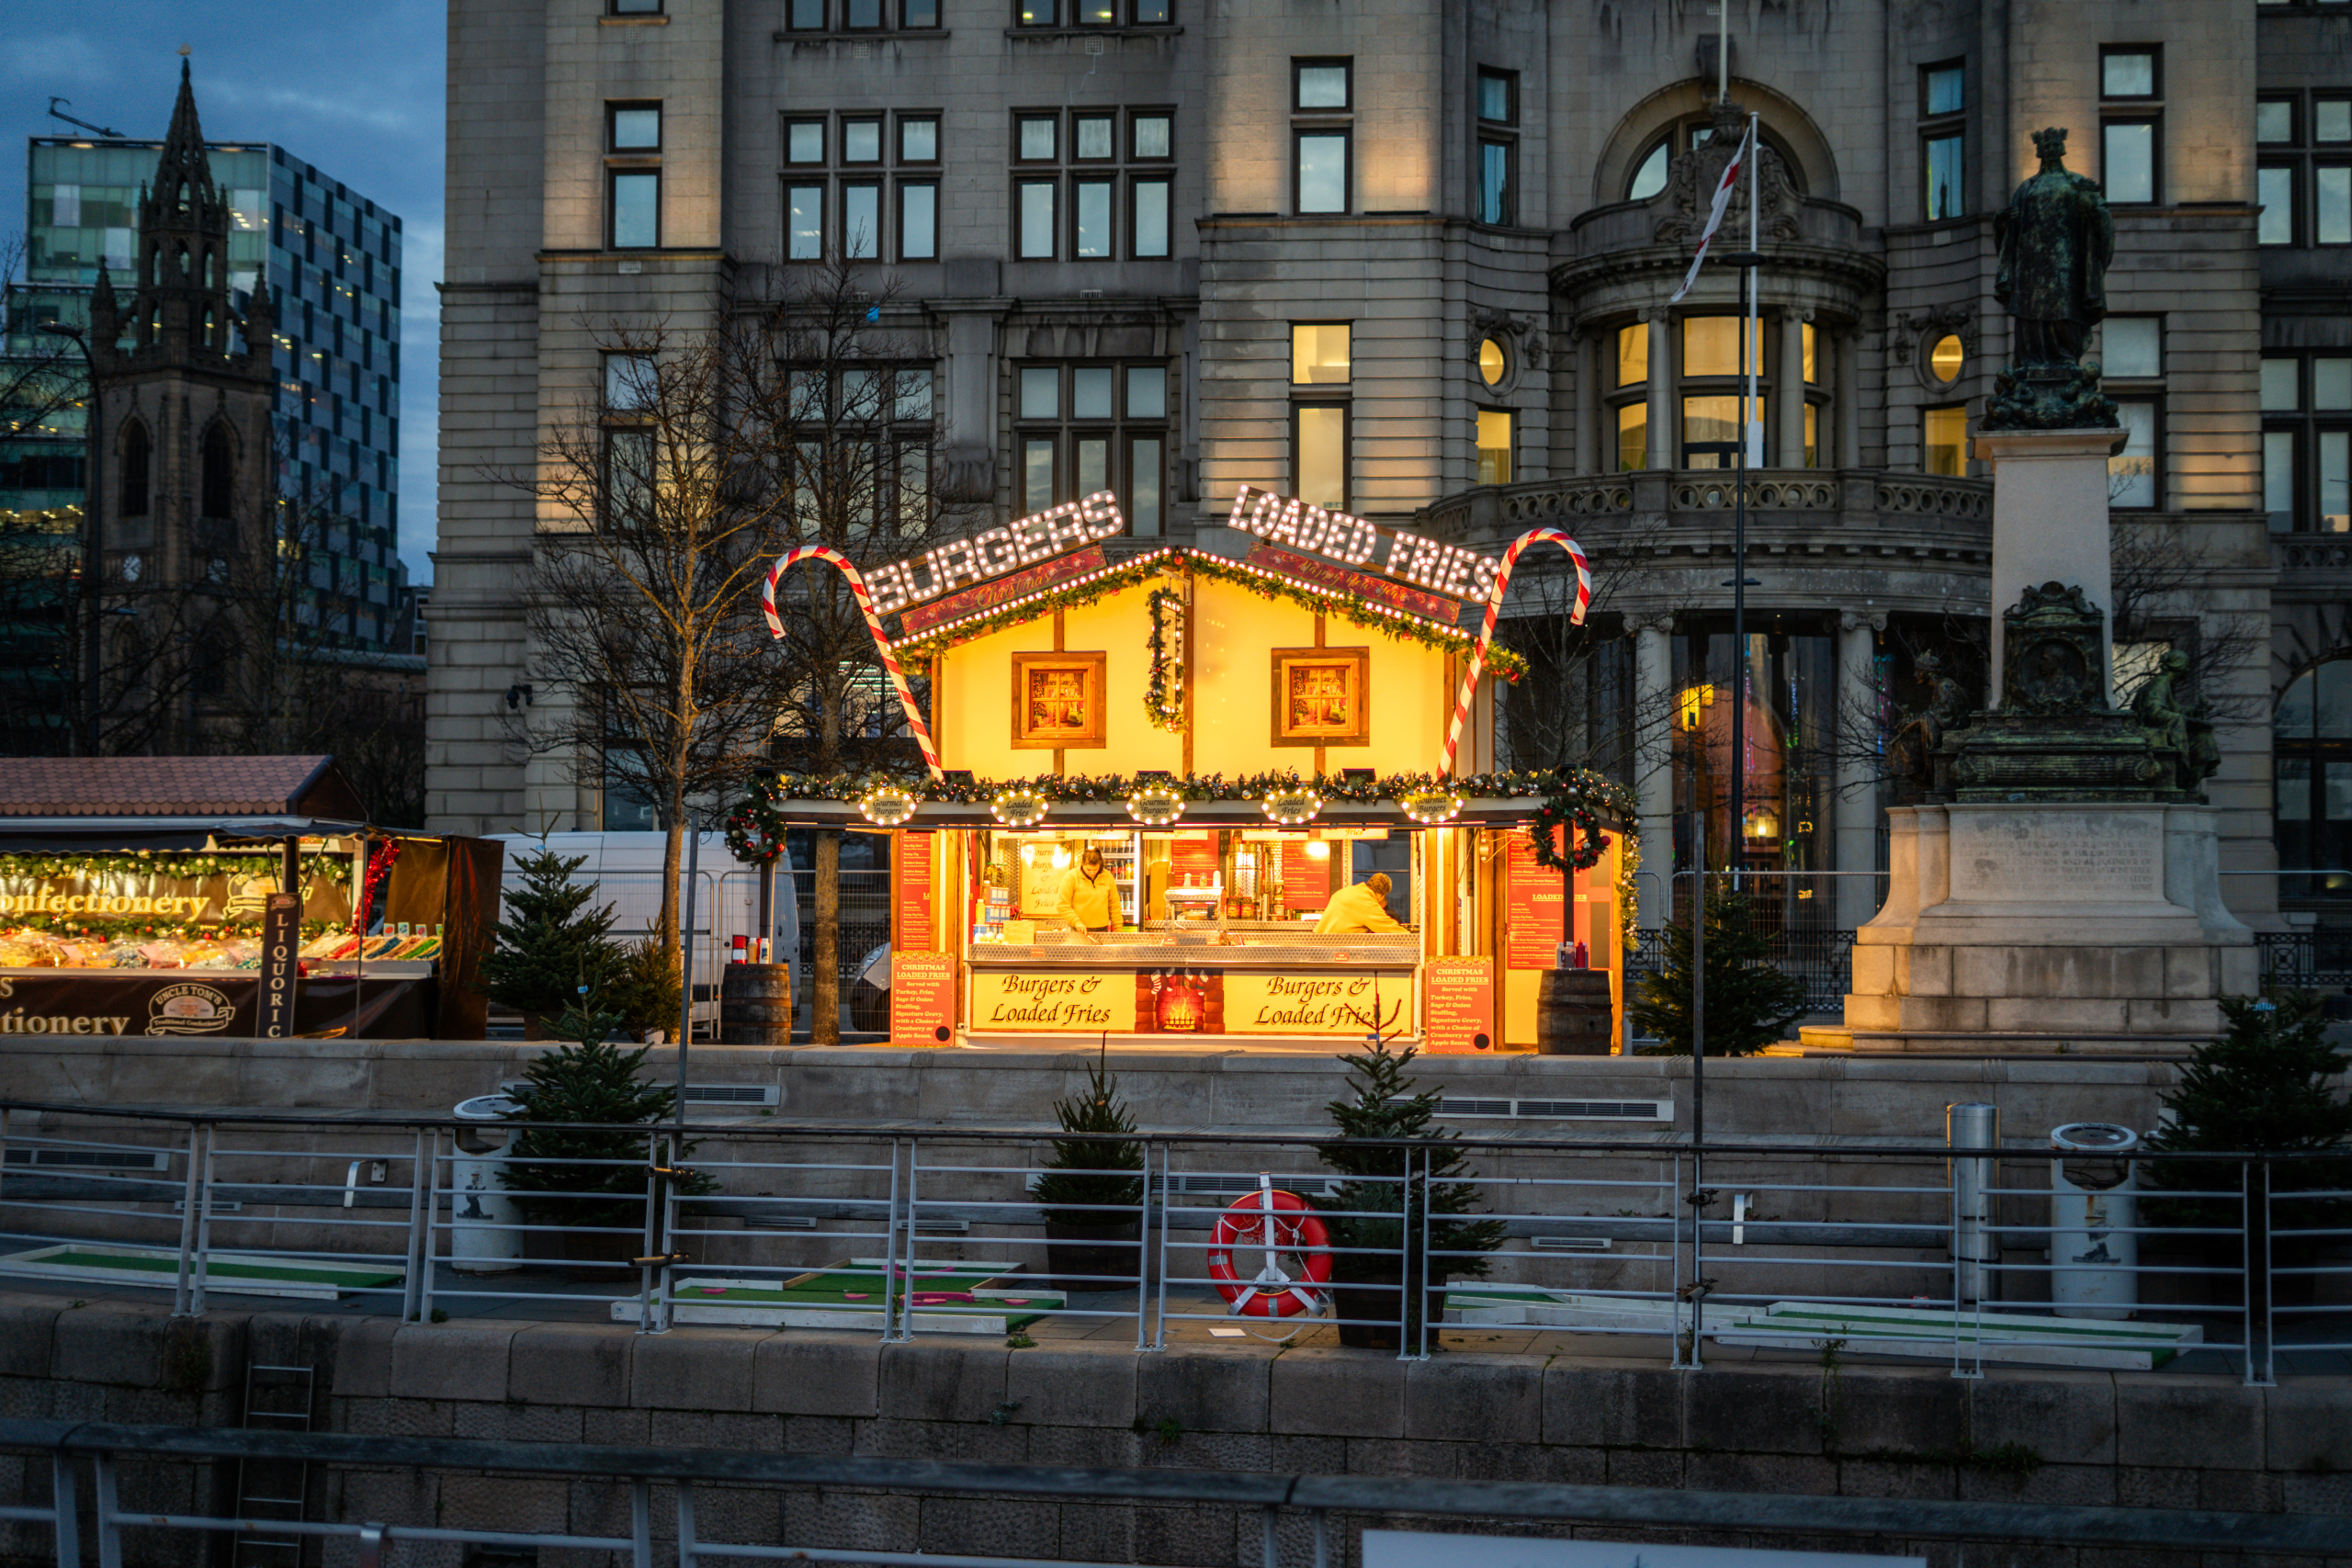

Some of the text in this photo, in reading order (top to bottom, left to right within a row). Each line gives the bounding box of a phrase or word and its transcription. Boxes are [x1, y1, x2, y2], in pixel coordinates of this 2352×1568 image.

[1228, 485, 1500, 603] LOADED FRIES
[864, 490, 1123, 616] BURGERS
[1300, 558, 1406, 600] Happy New Year
[974, 572, 1053, 607] Christmas
[873, 799, 902, 807] Gourmet
[1005, 799, 1033, 808] Loaded
[1140, 798, 1170, 807] Gourmet
[1277, 797, 1306, 806] Loaded
[1415, 796, 1447, 805] Gourmet
[874, 807, 902, 817] Burgers
[1011, 809, 1029, 817] Fries
[1141, 806, 1169, 817] Burgers
[1282, 807, 1301, 815] Fries
[1417, 805, 1446, 815] Burgers
[1034, 899, 1054, 908] Fries
[1003, 974, 1102, 1002] Burgers &
[1267, 976, 1371, 1004] Burgers &
[155, 986, 222, 1005] UNCLE TOM'S
[989, 1001, 1111, 1026] Loaded Fries
[1253, 1004, 1330, 1025] Loaded
[0, 1007, 130, 1035] tionery
